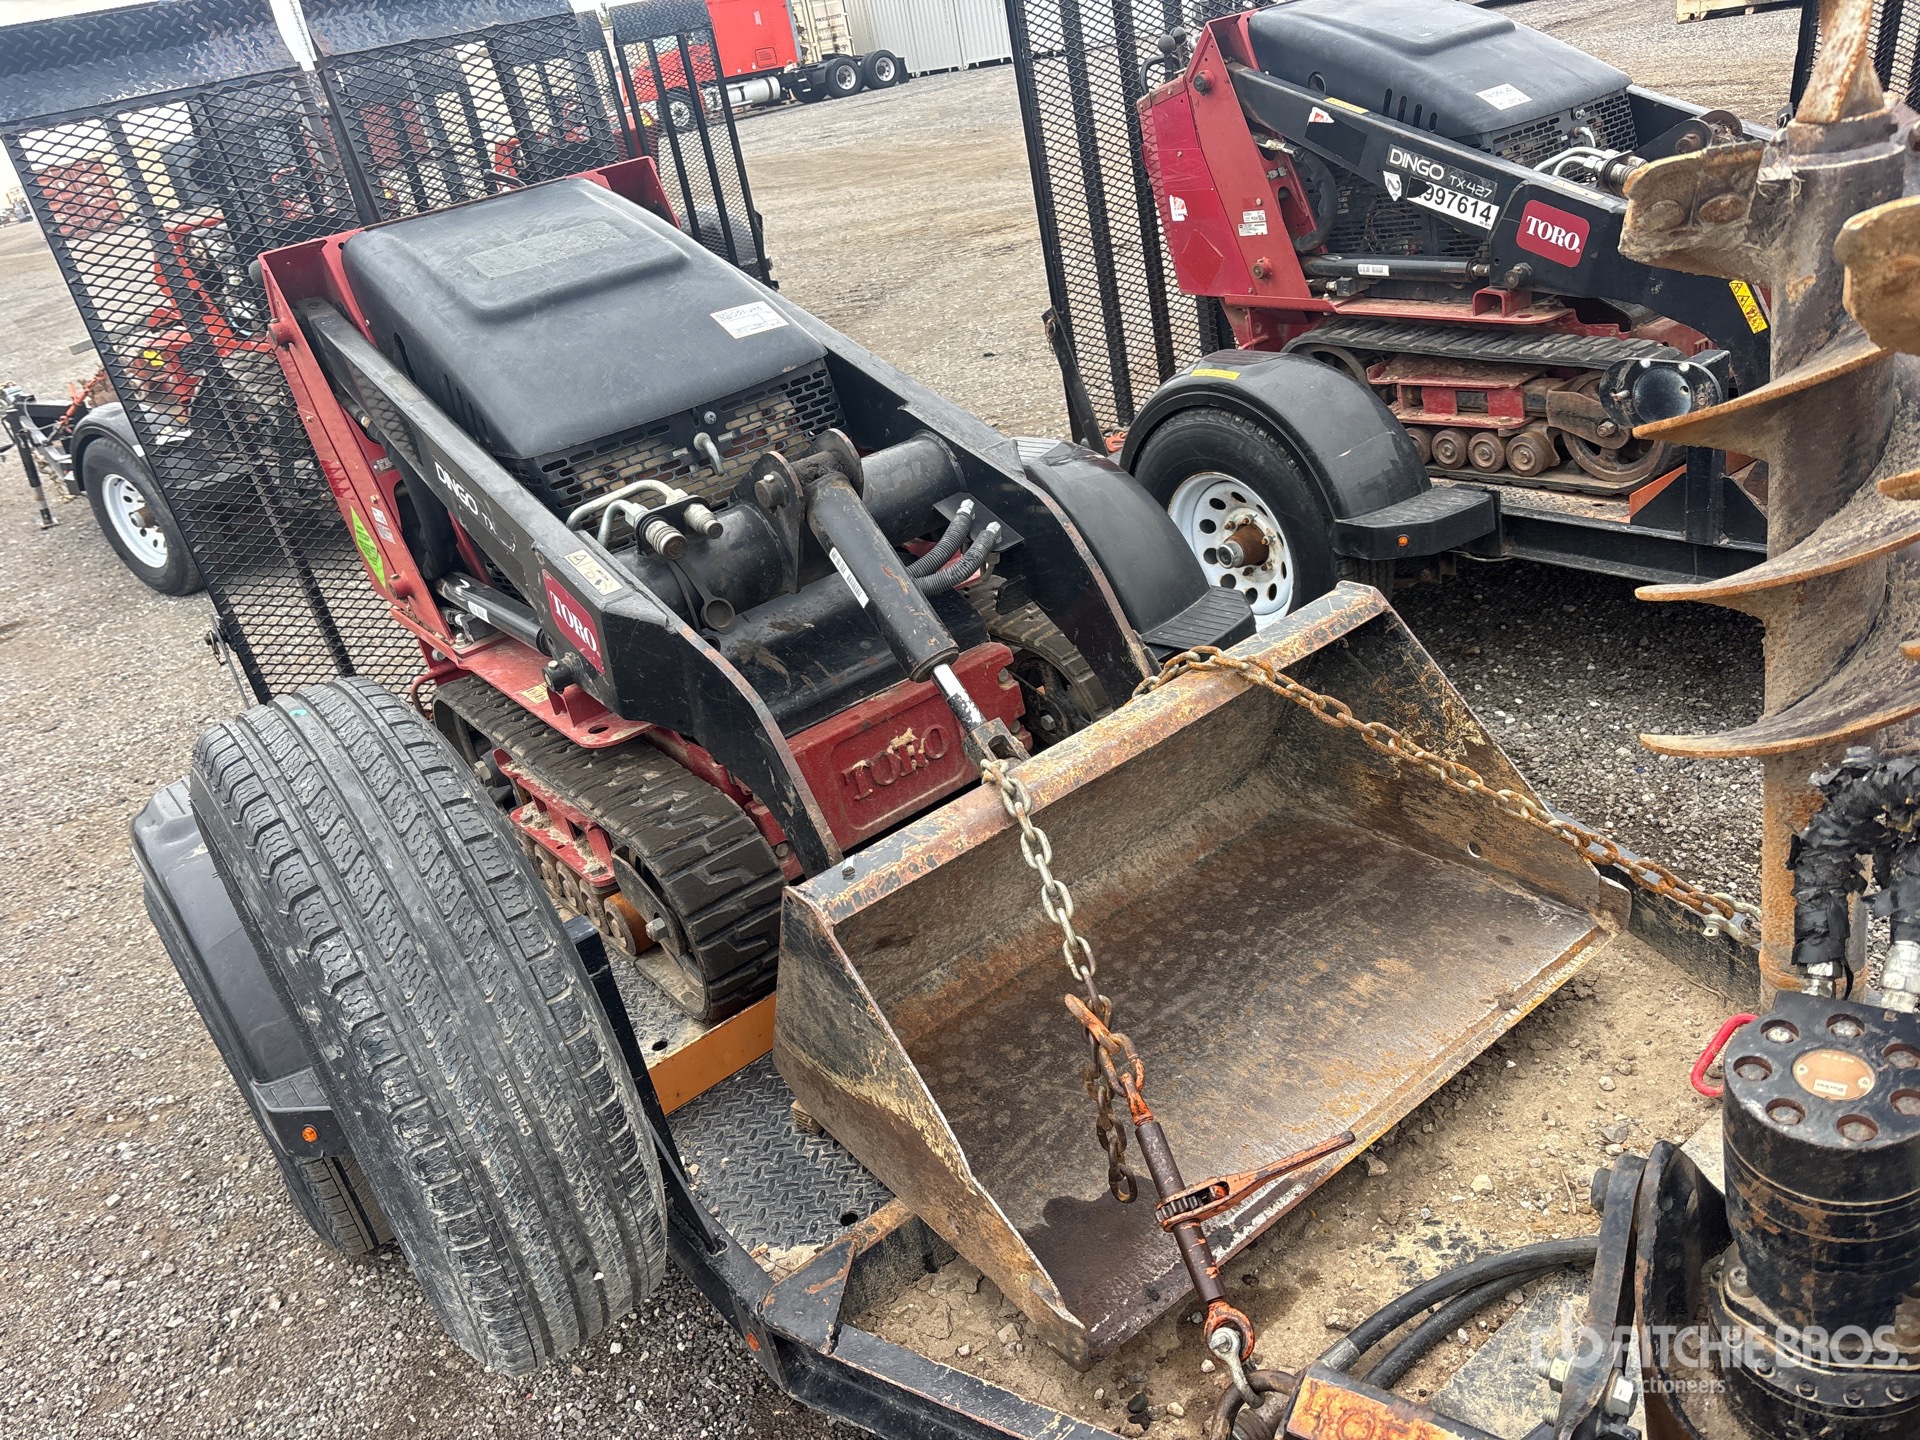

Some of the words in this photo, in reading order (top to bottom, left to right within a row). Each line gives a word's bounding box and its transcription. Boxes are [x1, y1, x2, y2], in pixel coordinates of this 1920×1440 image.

[1389, 148, 1445, 181] DINGO
[1418, 181, 1491, 222] 997614
[1525, 214, 1580, 252] TORO
[434, 461, 479, 516] DINGO
[549, 590, 597, 652] TORO
[841, 724, 949, 800] TORO
[495, 1071, 532, 1137] CARLISLE
